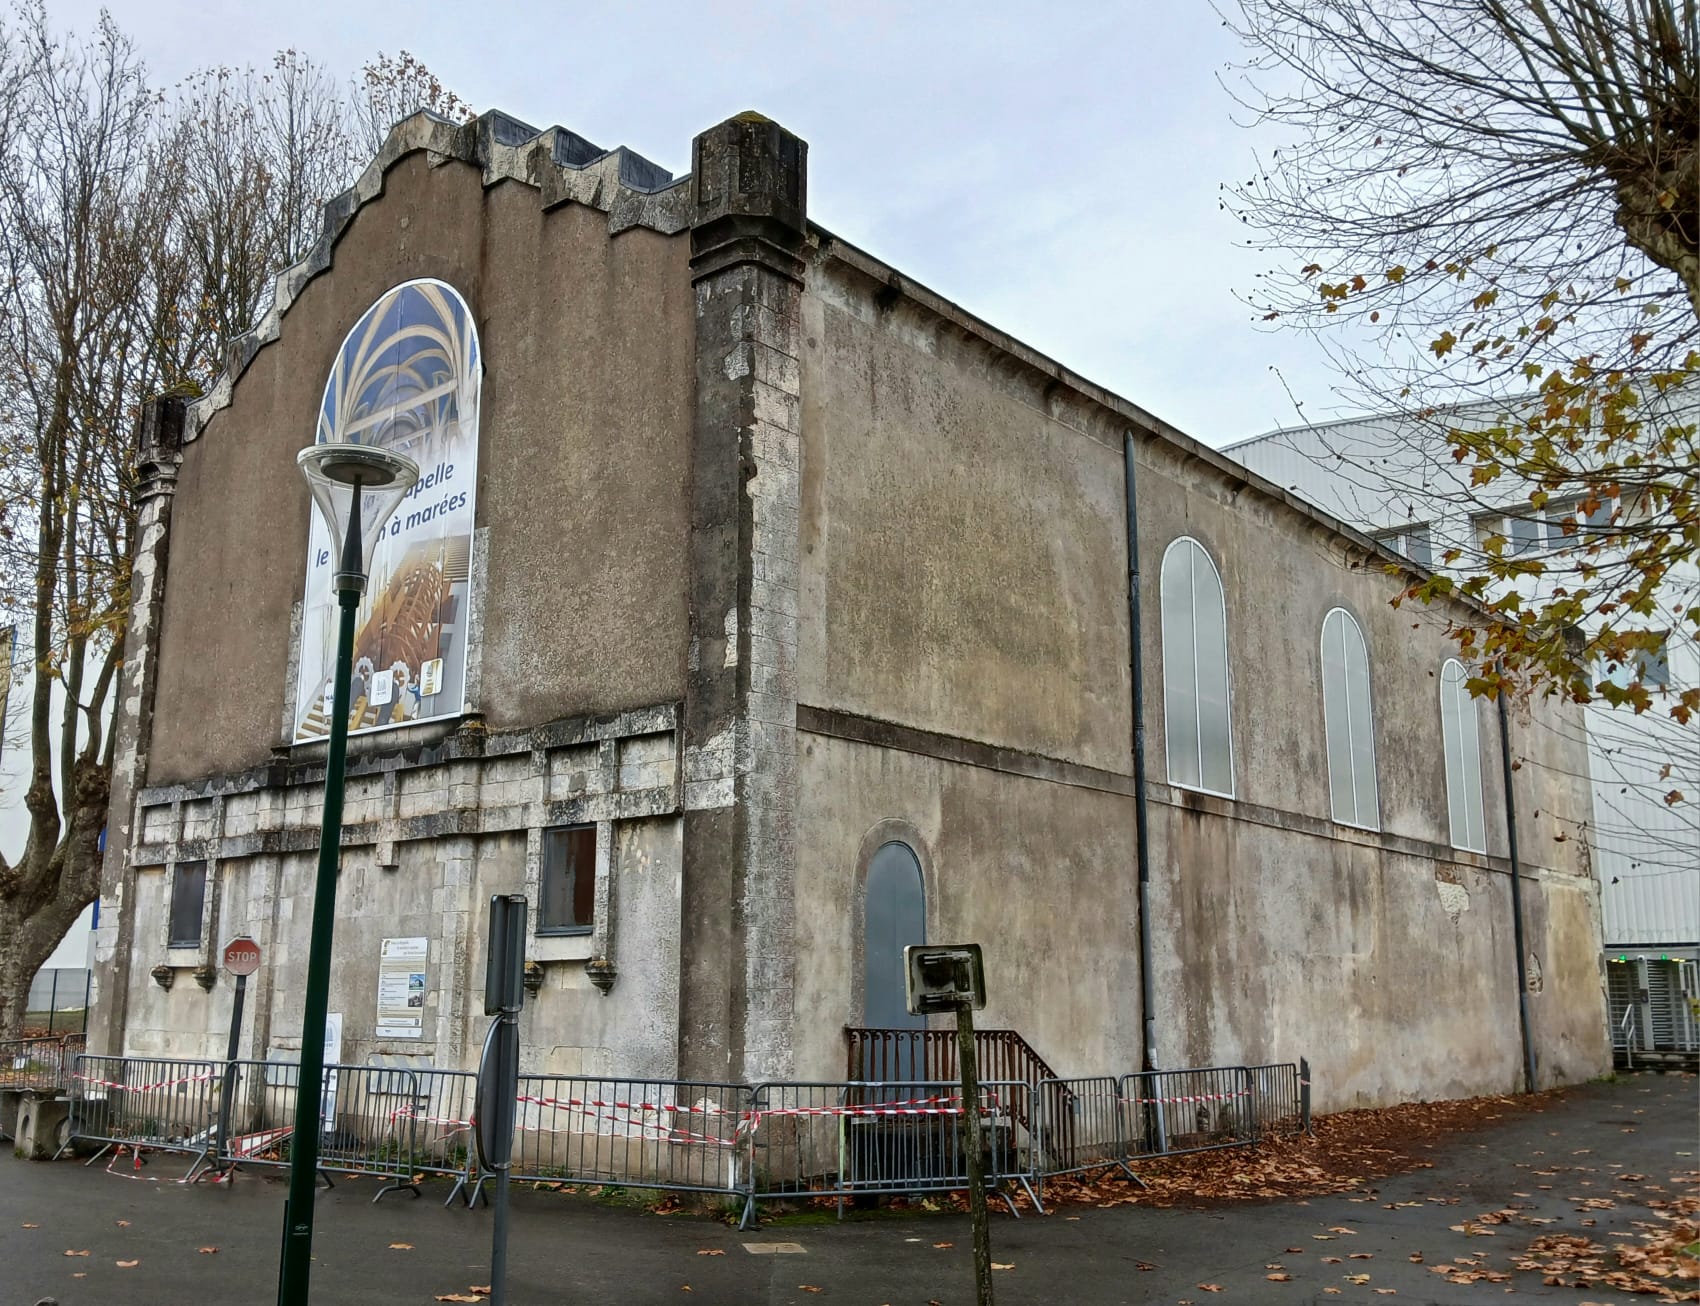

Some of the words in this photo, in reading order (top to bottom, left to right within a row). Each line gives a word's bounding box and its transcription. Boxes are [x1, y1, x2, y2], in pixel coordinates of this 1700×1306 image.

[404, 462, 454, 500] apelle
[315, 548, 329, 568] le
[390, 516, 401, 536] à
[405, 491, 467, 531] marées
[227, 951, 257, 963] STOP
